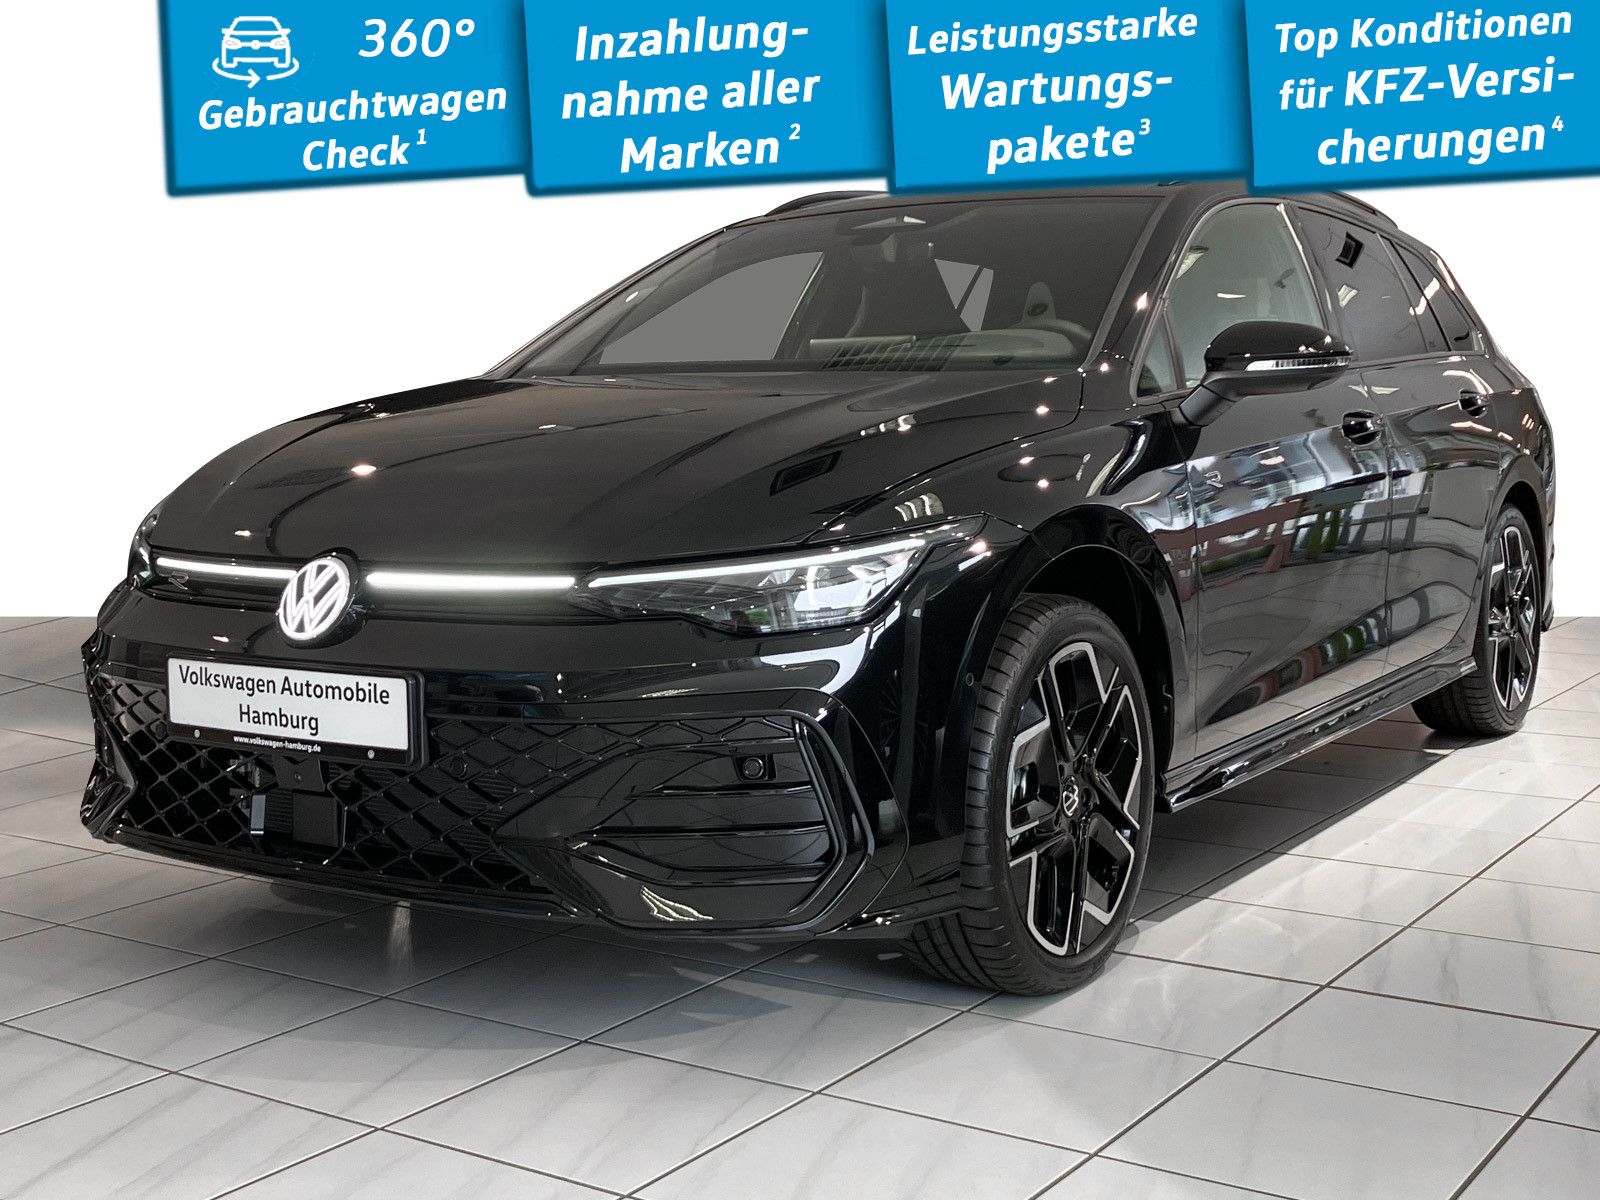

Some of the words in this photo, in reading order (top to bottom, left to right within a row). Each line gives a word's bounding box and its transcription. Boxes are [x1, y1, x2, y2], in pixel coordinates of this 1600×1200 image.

[178, 664, 276, 697] Volkswagen
[280, 675, 390, 705] Automobile
[239, 703, 319, 736] Hamburg
[233, 735, 321, 753] www.volkswagen-hamburg.de
